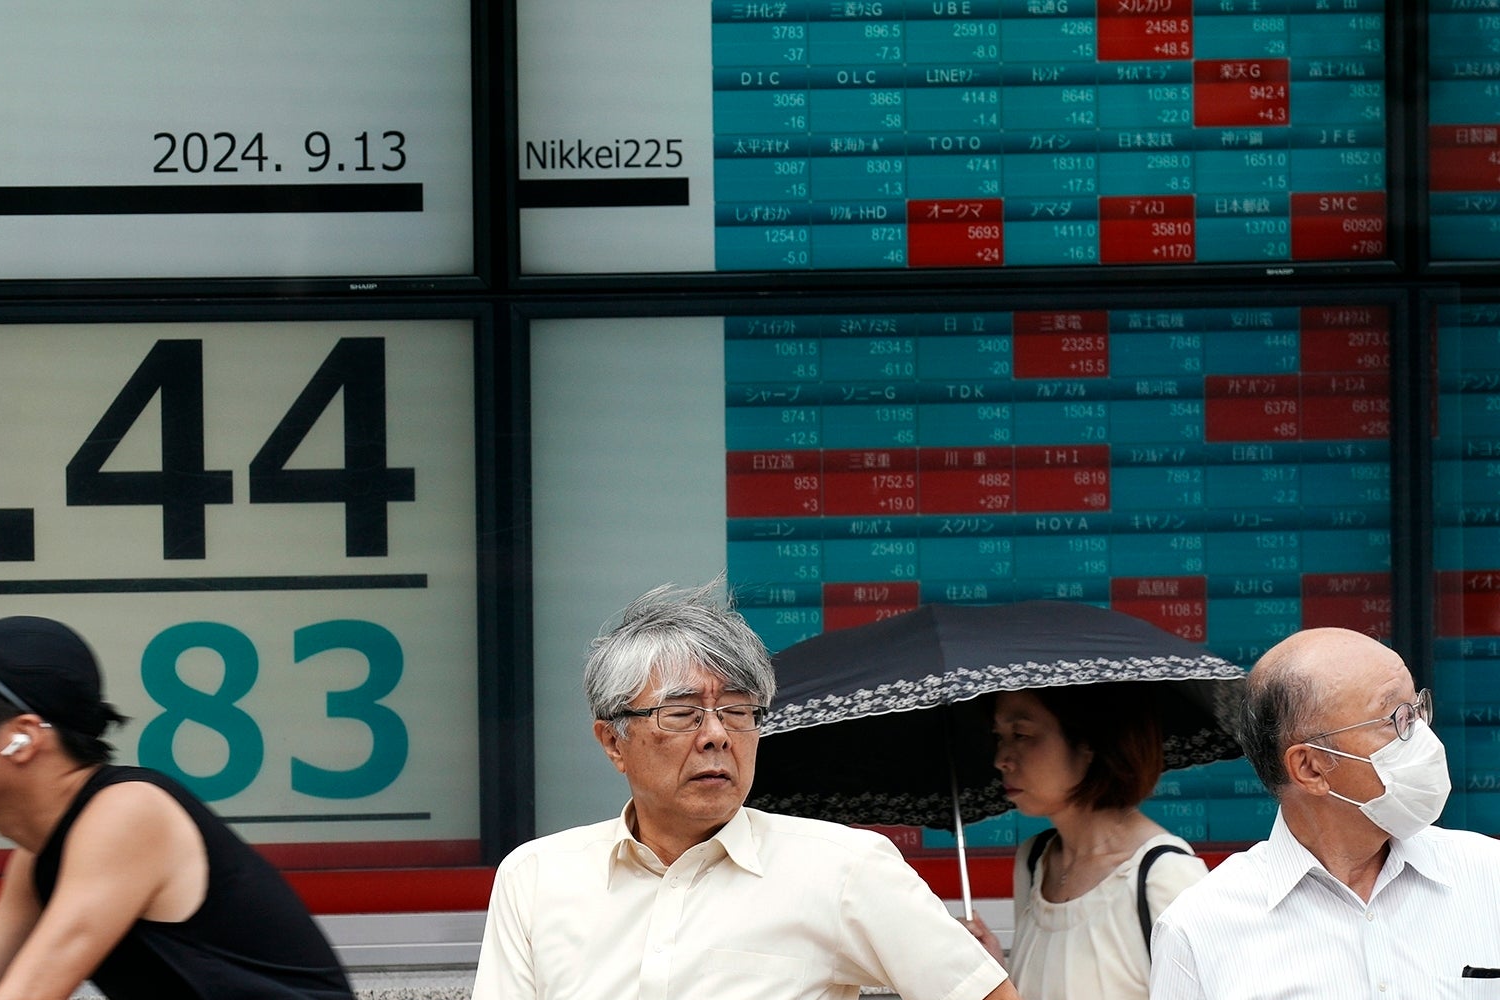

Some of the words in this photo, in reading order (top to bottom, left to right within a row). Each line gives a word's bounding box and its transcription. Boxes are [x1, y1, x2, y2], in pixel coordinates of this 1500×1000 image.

[934, 1, 970, 15] UBE
[773, 26, 804, 39] 3783
[865, 24, 900, 37] 896.5
[954, 23, 996, 36] 2591.0
[1062, 22, 1092, 34] 4286
[1146, 20, 1189, 34] 2458.5
[1073, 44, 1093, 56] -15
[1155, 42, 1189, 55] +48.5
[1360, 37, 1380, 52] -43
[784, 48, 803, 61] -37
[876, 47, 900, 59] -7.3
[973, 45, 996, 58] -8.0
[742, 72, 779, 85] DIC
[837, 71, 875, 83] OLC
[870, 92, 900, 104] 3865
[962, 91, 997, 103] 414.8
[1149, 87, 1189, 100] 1036.5
[1250, 86, 1284, 99] 942.4
[774, 94, 804, 106] 3056
[1066, 111, 1093, 124] -142
[1158, 110, 1189, 122] -22.0
[1259, 108, 1285, 121] +4.3
[1361, 106, 1380, 118] -54
[785, 116, 805, 128] -16
[882, 114, 901, 127] -58
[974, 113, 996, 125] -1.4
[929, 137, 980, 150] TOTO
[1119, 133, 1173, 147] 日本製鉄
[1320, 130, 1355, 144] JFE
[153, 131, 282, 174] 2024.
[304, 130, 407, 173] 9.13
[525, 138, 683, 170] Nikkei225
[1341, 152, 1382, 165] 1852.0
[967, 159, 996, 170] 4741
[1053, 157, 1094, 169] 1831.0
[1148, 156, 1189, 168] 2988.0
[1244, 153, 1285, 166] 1651.0
[775, 161, 805, 174] 3087
[867, 160, 902, 173] 830.9
[979, 181, 998, 193] -38
[1063, 179, 1094, 191] -17.5
[1166, 177, 1190, 189] -8.5
[1262, 175, 1286, 188] -1.5
[786, 183, 806, 196] -15
[879, 182, 902, 195] -1.3
[1320, 197, 1356, 211] SMC
[928, 204, 982, 218] オークマ
[1152, 222, 1191, 235] 35810
[1246, 221, 1286, 233] 1370.0
[1343, 219, 1381, 232] 60920
[766, 230, 806, 242] 1254.0
[872, 228, 901, 240] 8721
[968, 226, 999, 239] 5693
[1065, 246, 1095, 259] -16.5
[1153, 244, 1191, 257] +1170
[1263, 242, 1286, 256] -2.0
[1352, 240, 1380, 253] +780
[783, 251, 807, 264] -5.0
[884, 250, 903, 262] -46
[977, 248, 999, 261] +24
[947, 385, 983, 398] TDK
[1046, 450, 1078, 464] IHI
[1036, 517, 1088, 530] HOYA
